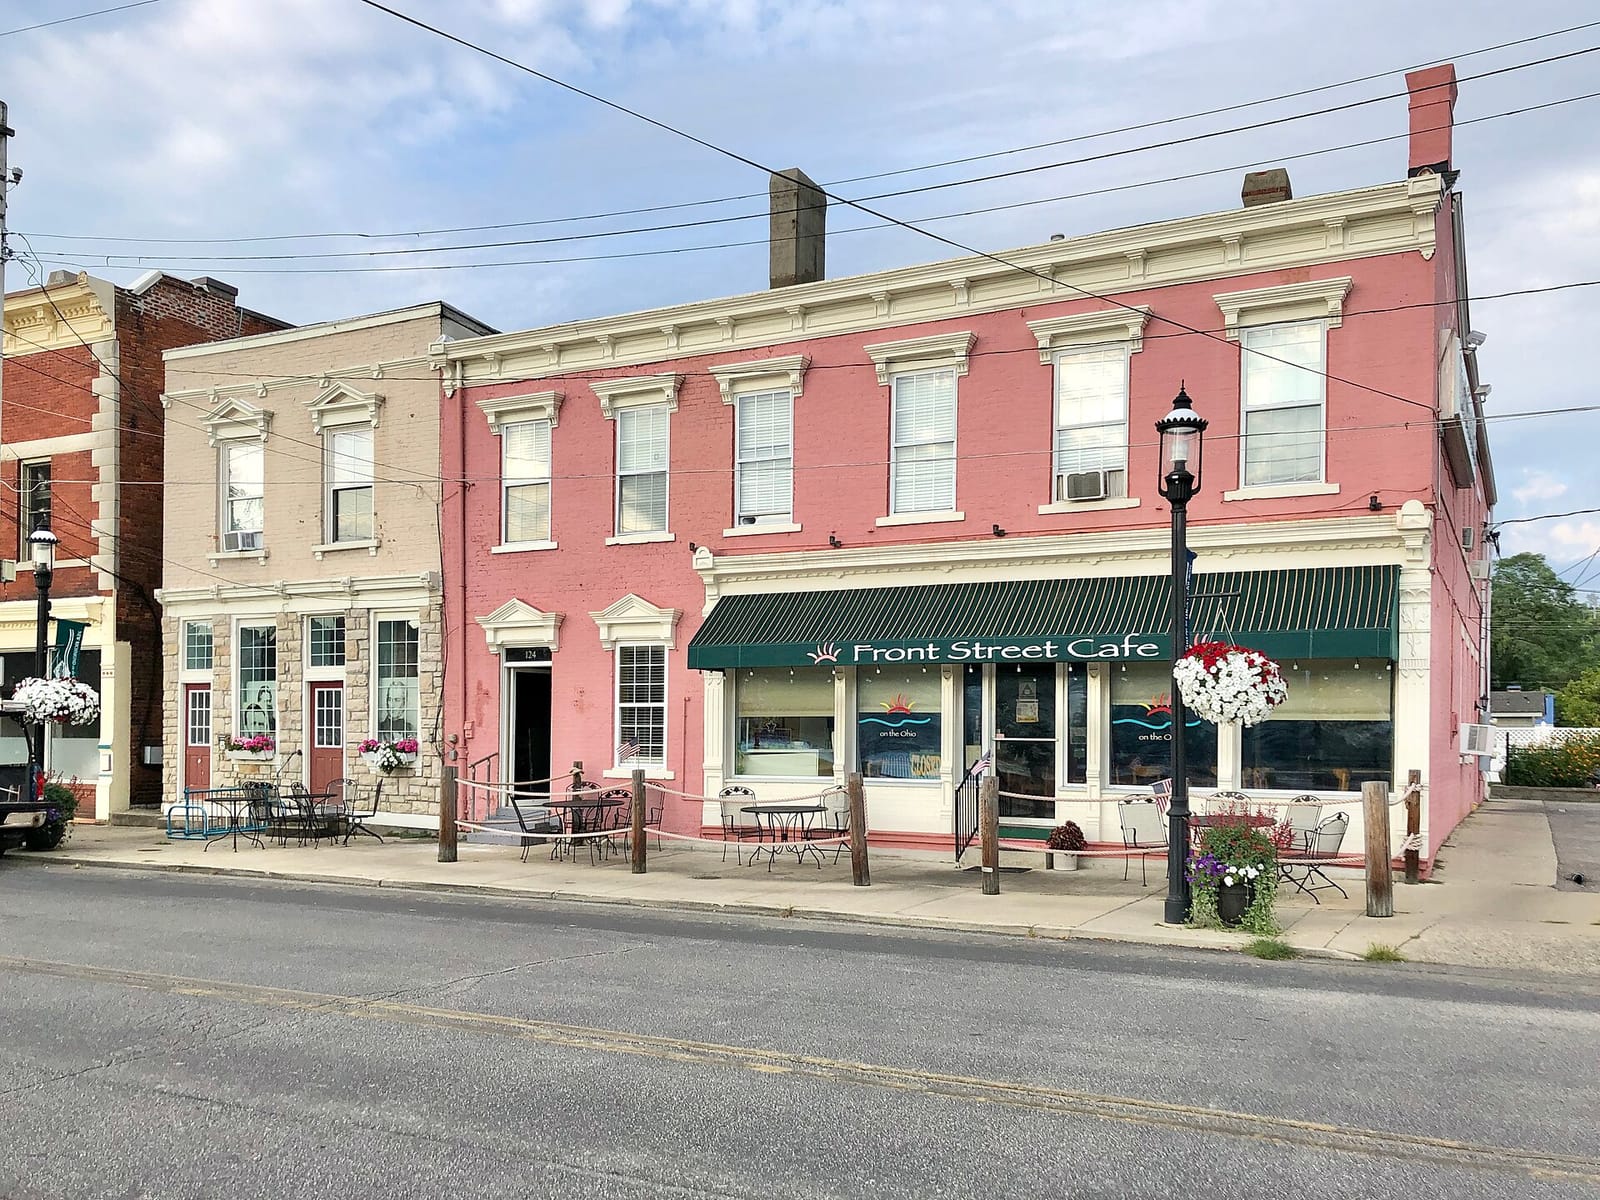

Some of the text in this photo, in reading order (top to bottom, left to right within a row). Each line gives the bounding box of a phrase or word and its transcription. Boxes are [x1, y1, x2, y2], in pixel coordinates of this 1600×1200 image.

[853, 632, 1159, 662] Front Street Cafe
[525, 650, 537, 659] 124
[889, 729, 899, 737] the
[900, 729, 917, 737] Ohio
[1150, 732, 1162, 741] the
